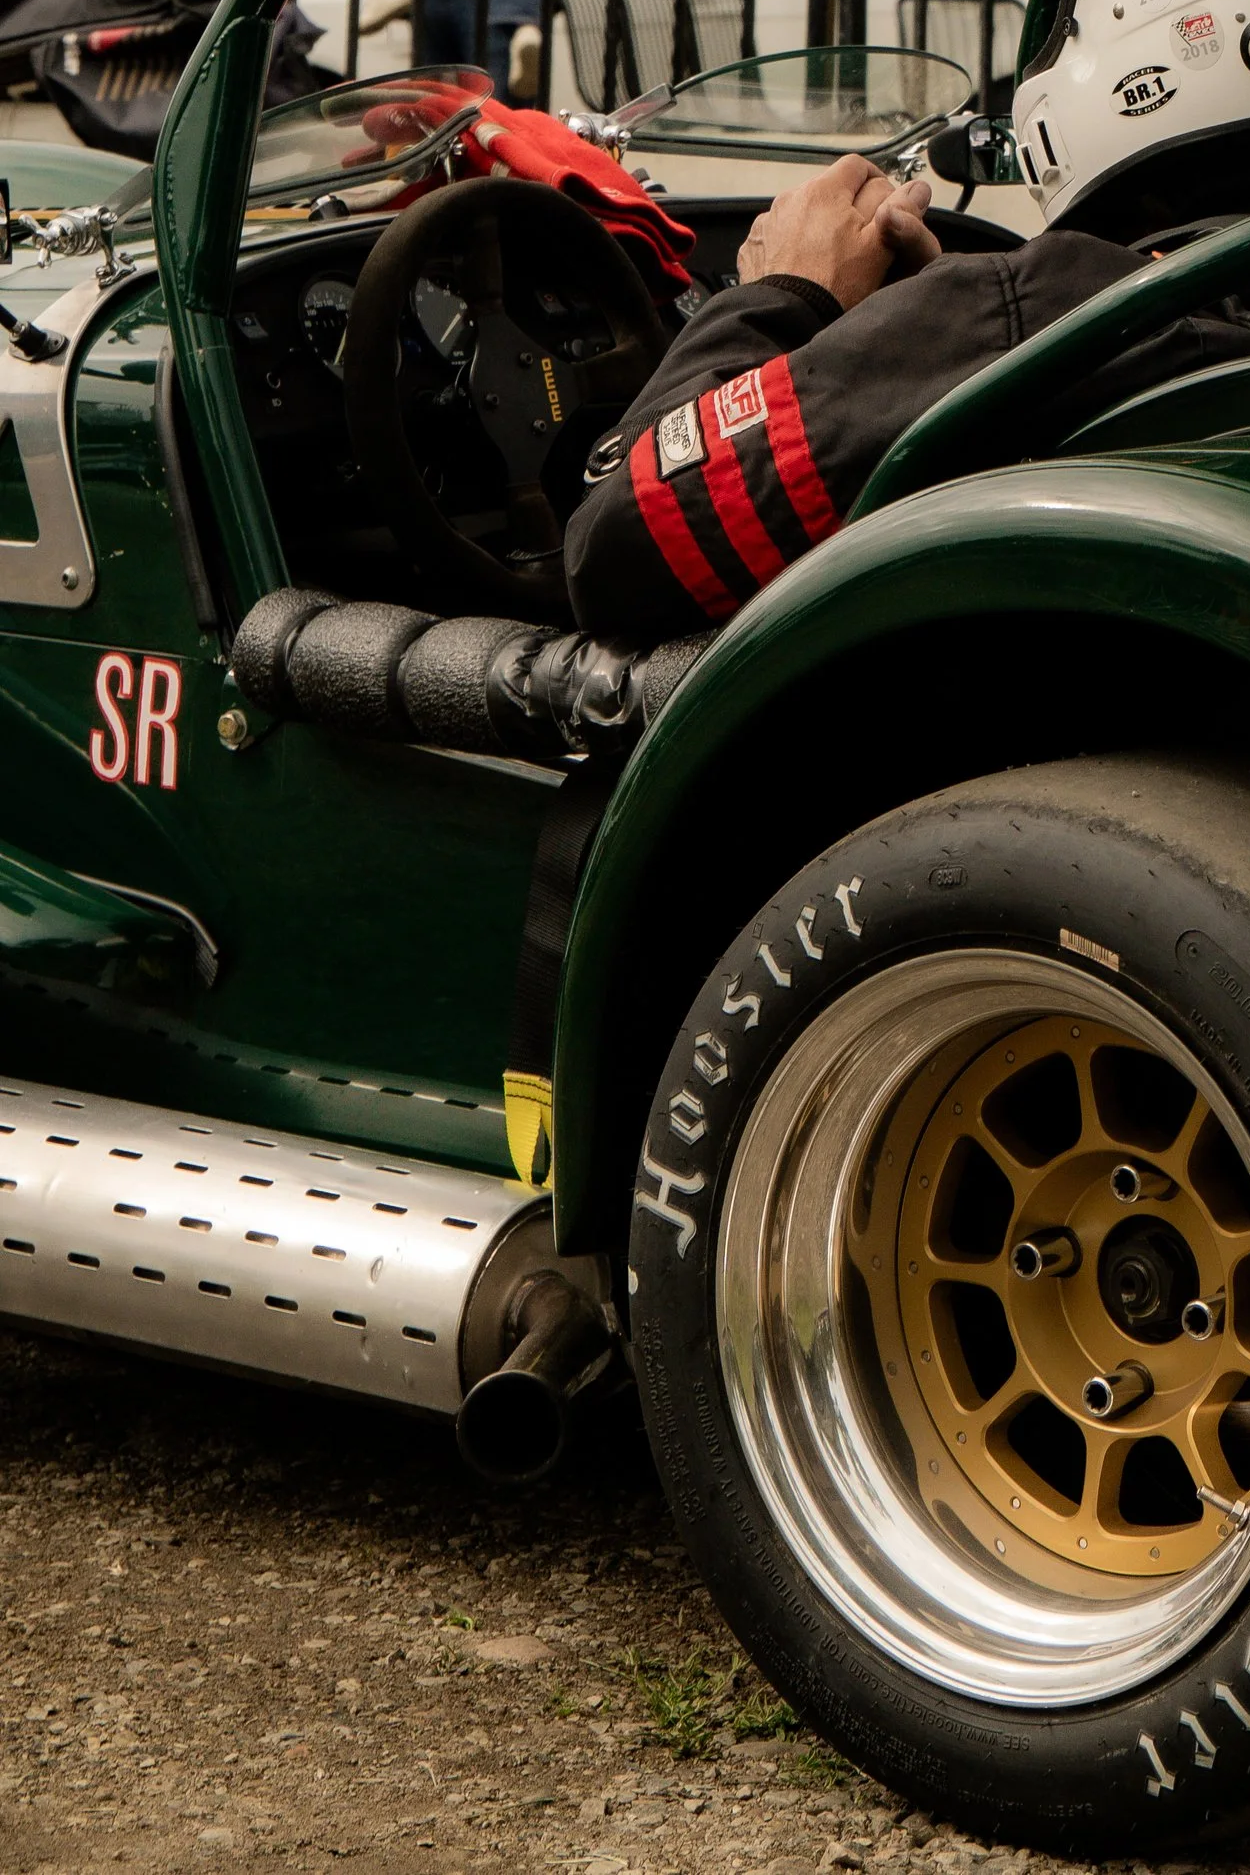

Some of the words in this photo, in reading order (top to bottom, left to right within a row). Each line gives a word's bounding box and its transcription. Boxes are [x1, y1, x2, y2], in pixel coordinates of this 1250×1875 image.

[1181, 39, 1220, 61] 2018
[1122, 67, 1155, 86] RACER
[1123, 76, 1165, 107] BR.1
[1130, 96, 1169, 115] SERIES
[89, 651, 182, 790] SR
[636, 875, 867, 1258] Hoosier
[690, 1379, 728, 1473] WARNINGS
[717, 1476, 758, 1544] SAFETY
[817, 1632, 847, 1664] FOR
[847, 1663, 996, 1745] www.hoosiertire.com
[1002, 1734, 1029, 1749] SEE
